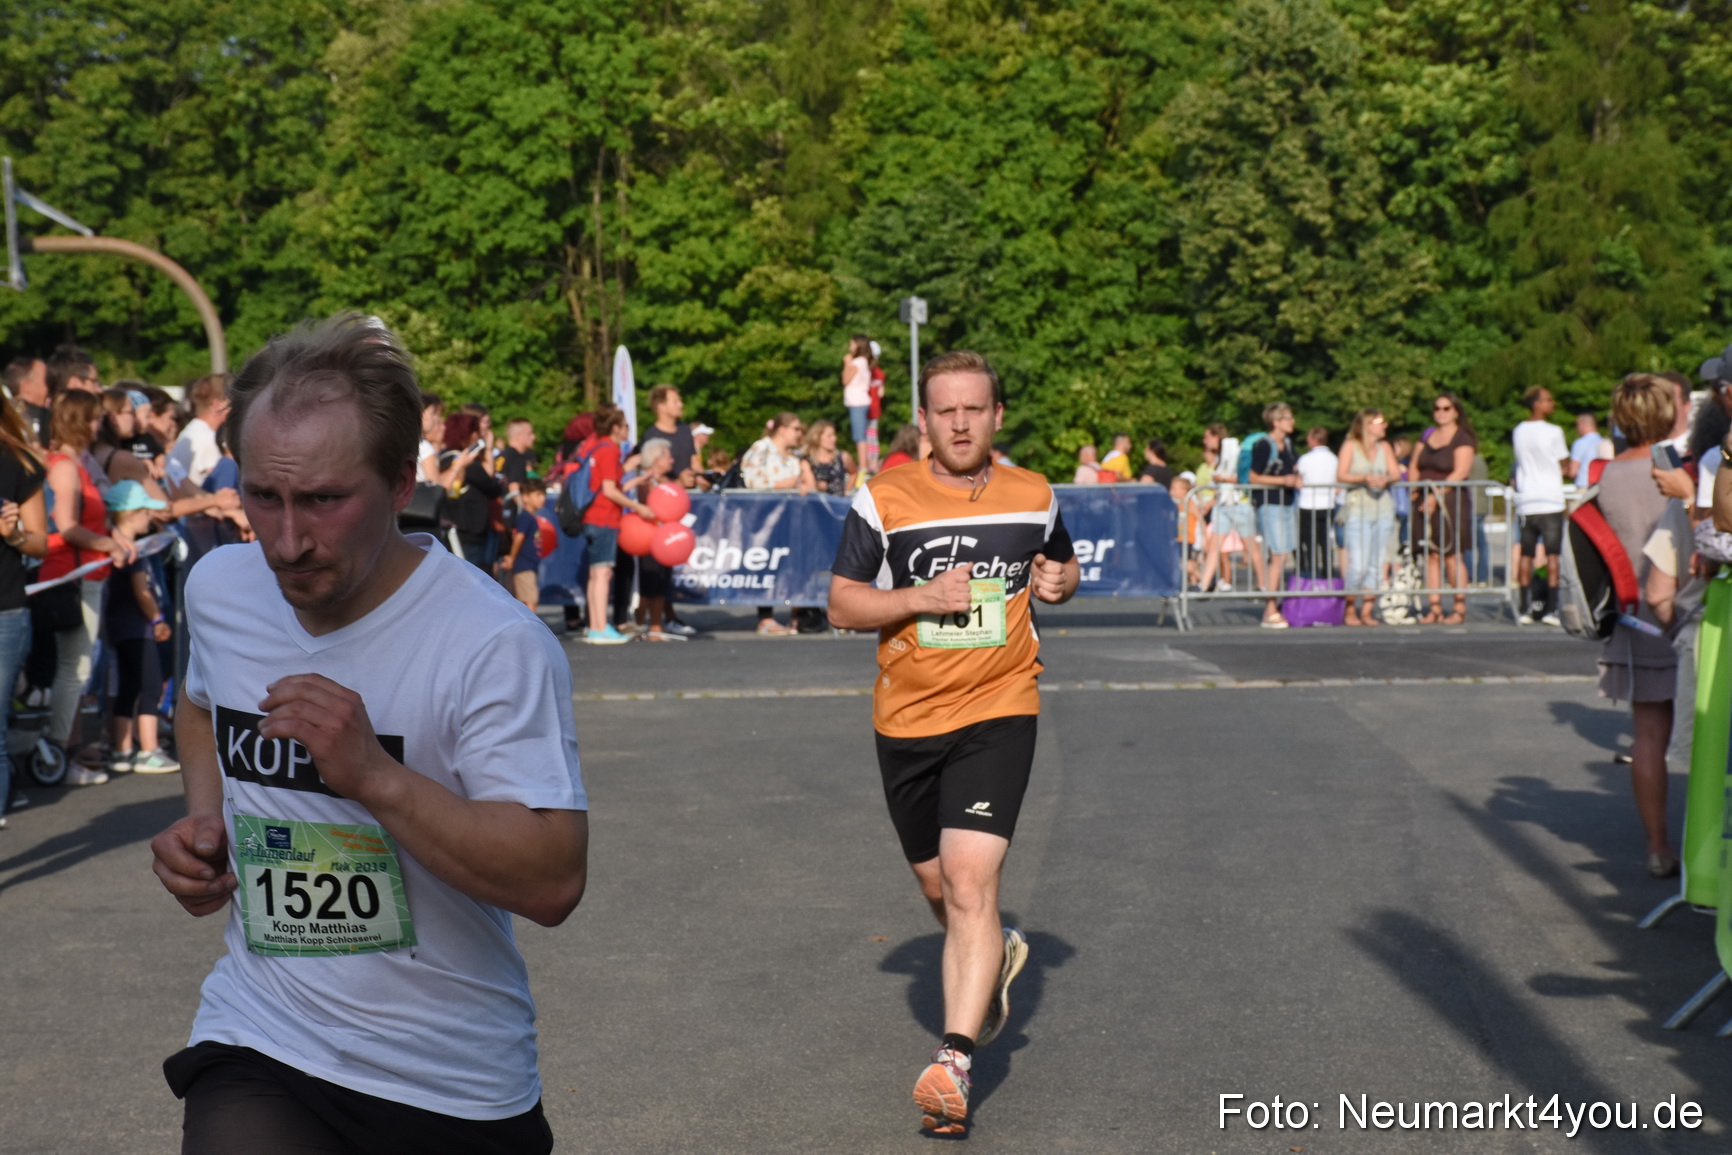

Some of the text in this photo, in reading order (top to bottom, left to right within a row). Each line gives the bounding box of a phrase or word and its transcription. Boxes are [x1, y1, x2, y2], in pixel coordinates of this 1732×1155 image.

[689, 538, 790, 571] cher
[673, 574, 776, 589] TOMOBILE
[965, 629, 993, 637] Stephan
[228, 726, 326, 784] KOP
[355, 861, 387, 872] 2019
[256, 868, 380, 920] 1520
[272, 920, 367, 935] Kopp Matthias
[264, 933, 382, 946] Matthias Kopp Schlosserei
